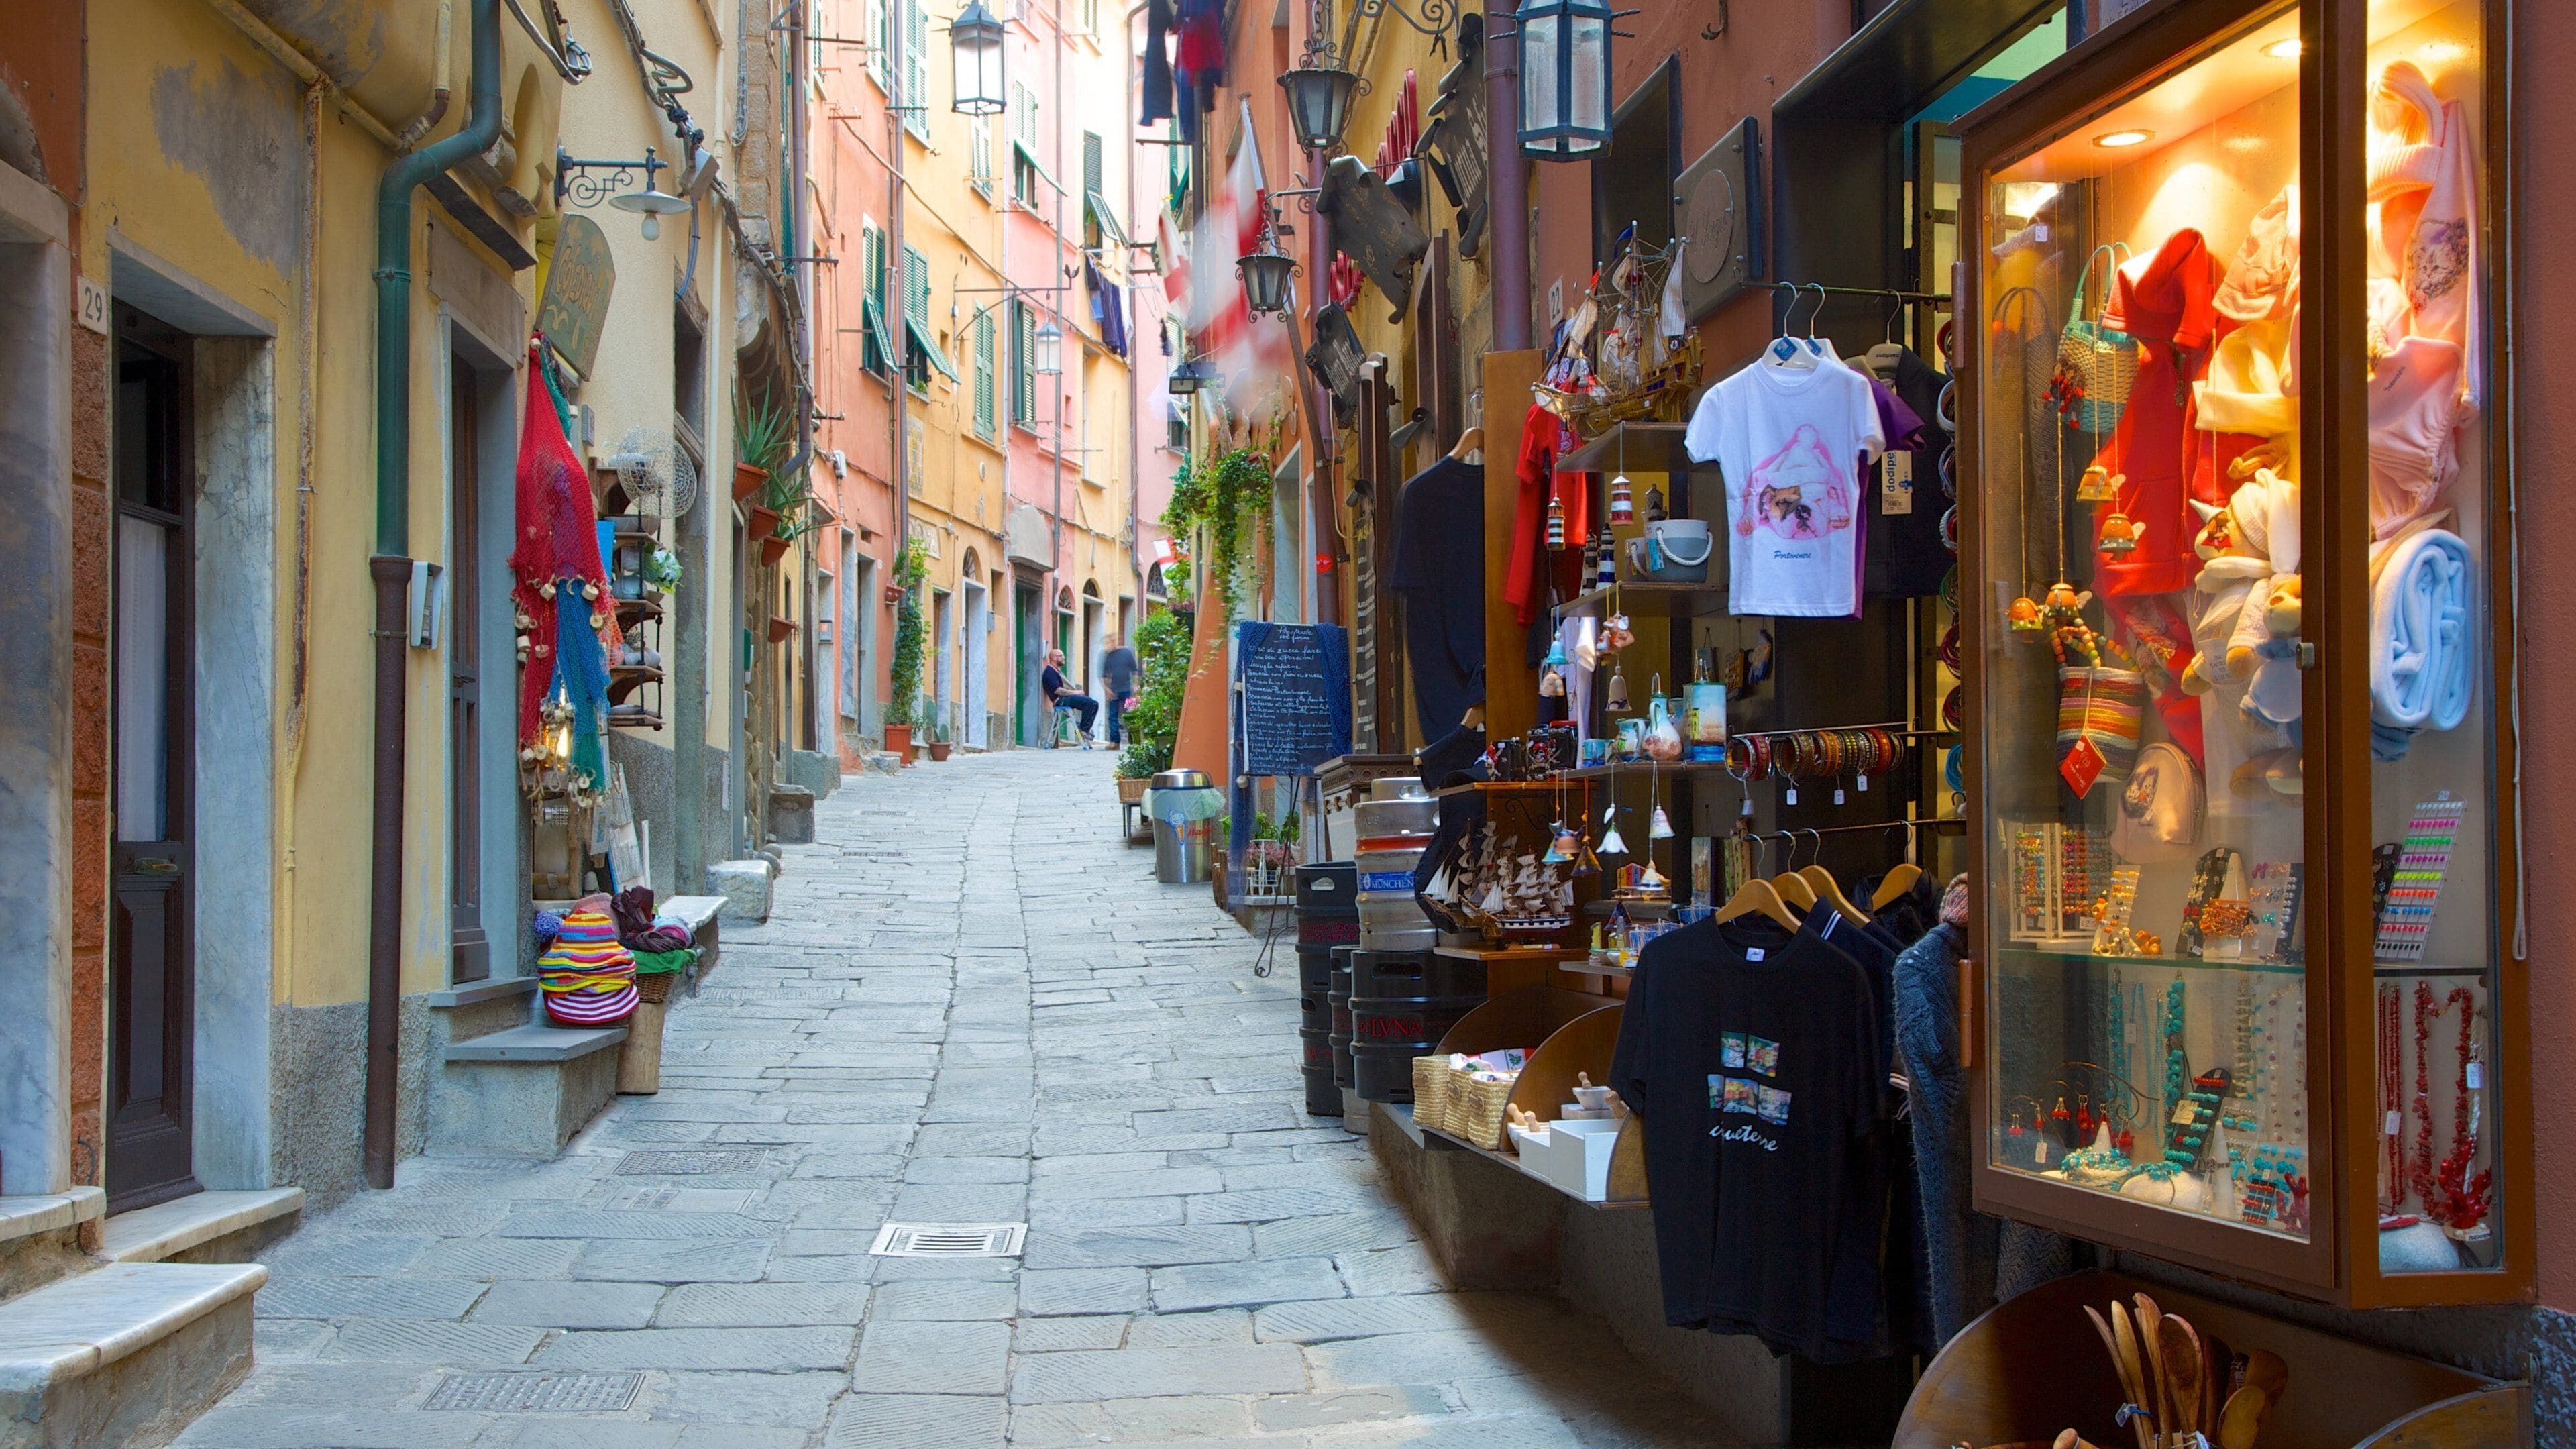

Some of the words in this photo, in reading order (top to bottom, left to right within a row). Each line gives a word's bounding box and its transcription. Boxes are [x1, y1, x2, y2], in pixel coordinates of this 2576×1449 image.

[85, 286, 102, 322] 29
[1551, 286, 1560, 320] 22
[1370, 1018, 1426, 1038] LVNA
